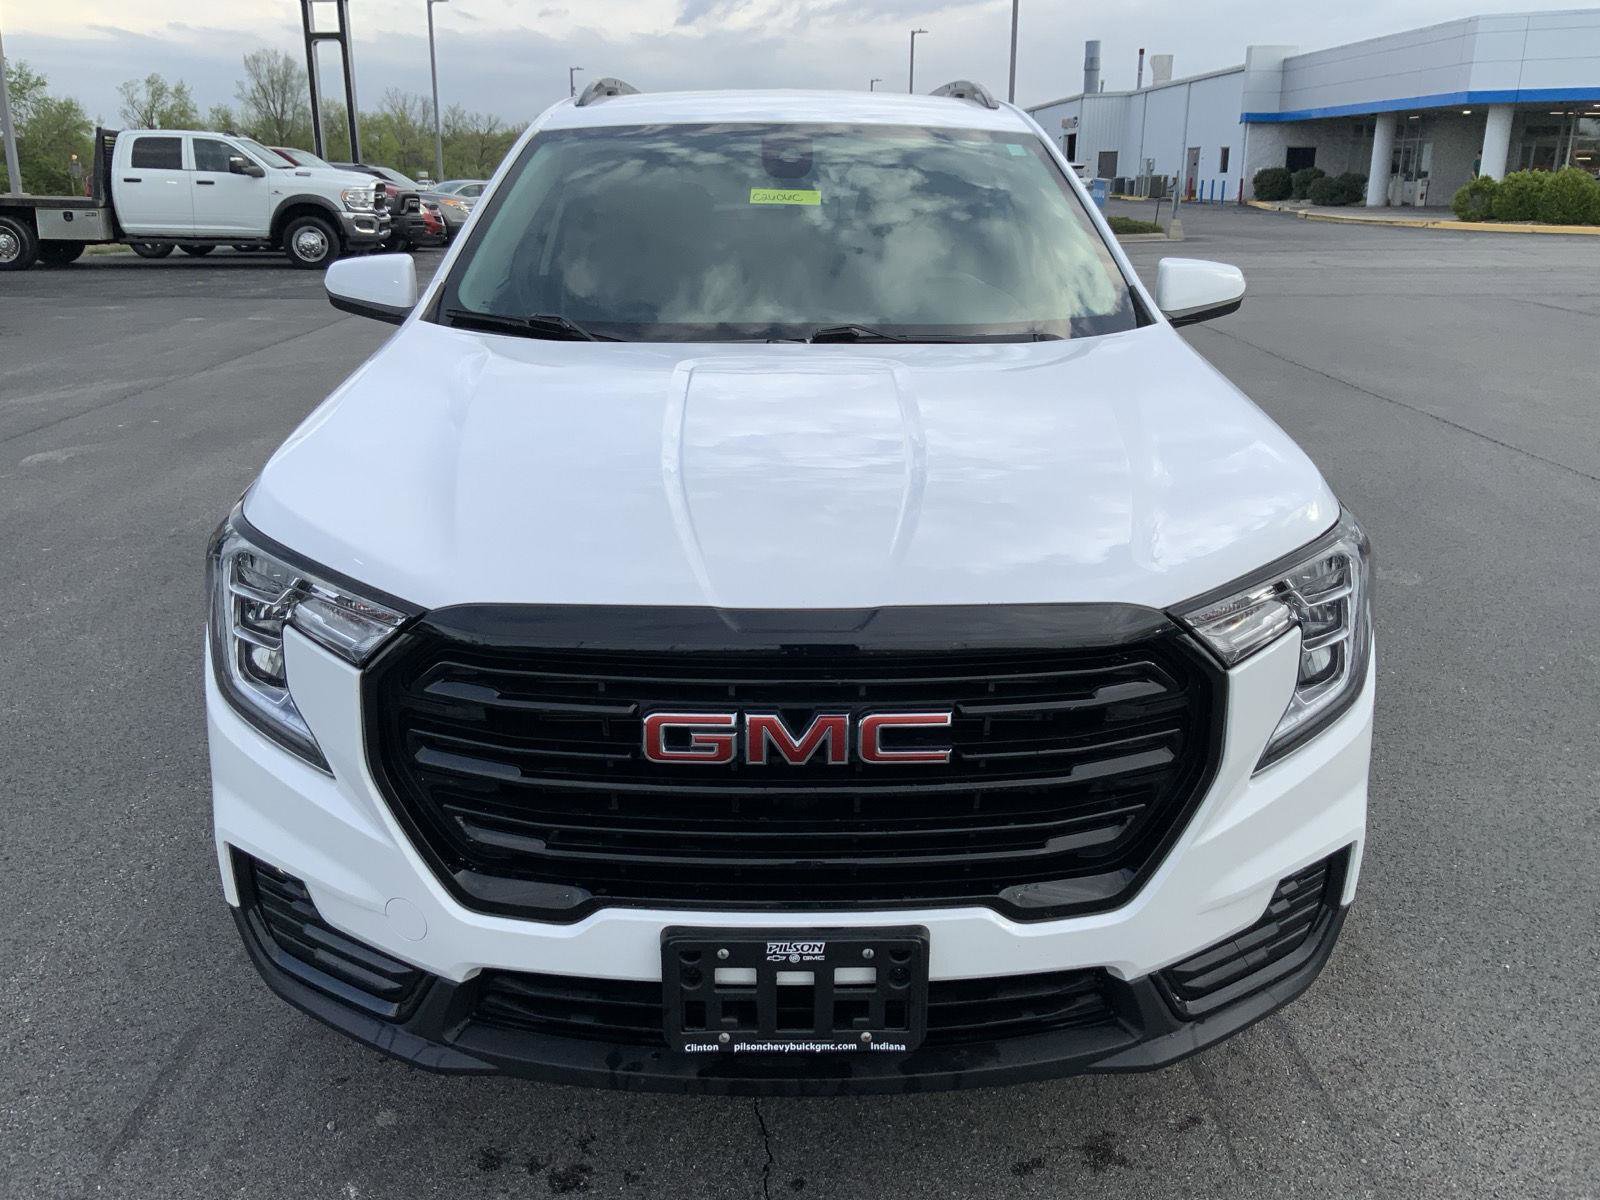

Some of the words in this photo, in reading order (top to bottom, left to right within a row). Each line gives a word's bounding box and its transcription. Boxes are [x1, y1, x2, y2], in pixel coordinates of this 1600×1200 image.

[643, 711, 953, 766] GMC
[767, 942, 826, 954] PILSON
[684, 1043, 719, 1052] Clinton
[734, 1042, 857, 1053] pilsonchevybuickgmc.com
[870, 1041, 906, 1051] Indiana
